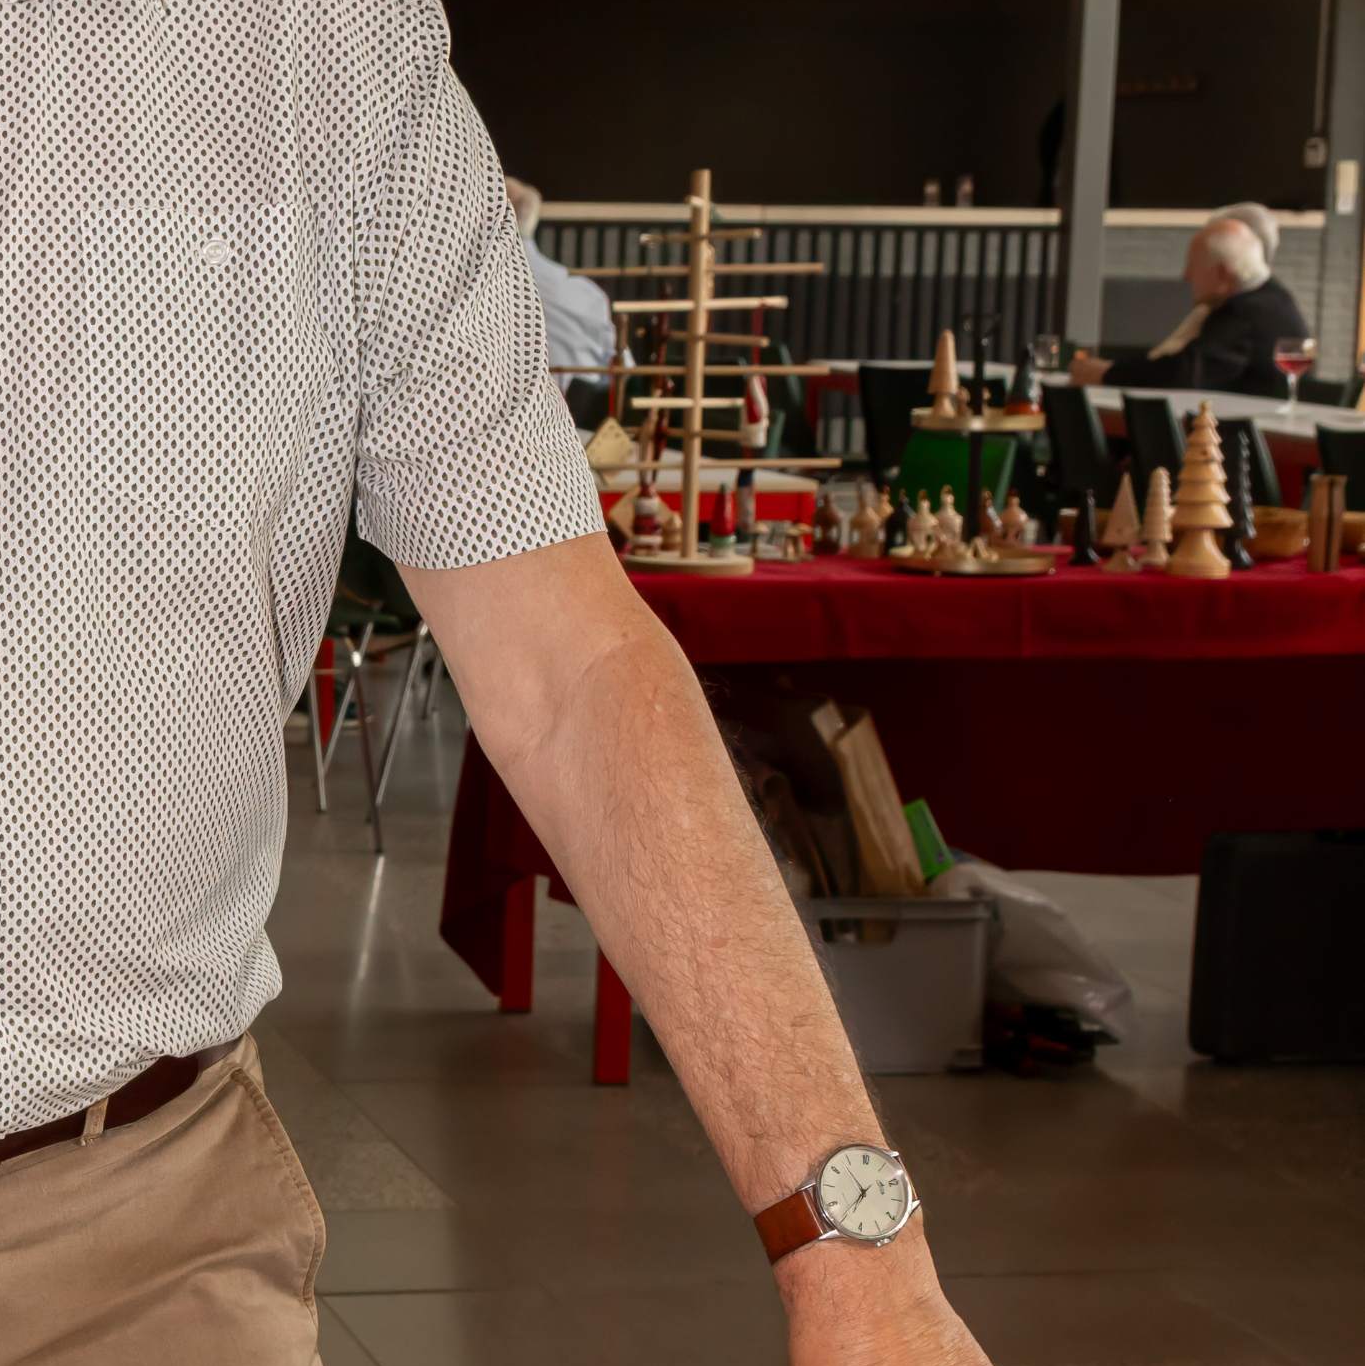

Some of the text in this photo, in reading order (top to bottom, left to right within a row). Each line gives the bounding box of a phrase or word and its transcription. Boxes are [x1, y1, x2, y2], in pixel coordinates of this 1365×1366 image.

[862, 1154, 870, 1165] 10
[888, 1178, 899, 1188] 12
[885, 1211, 896, 1221] 2
